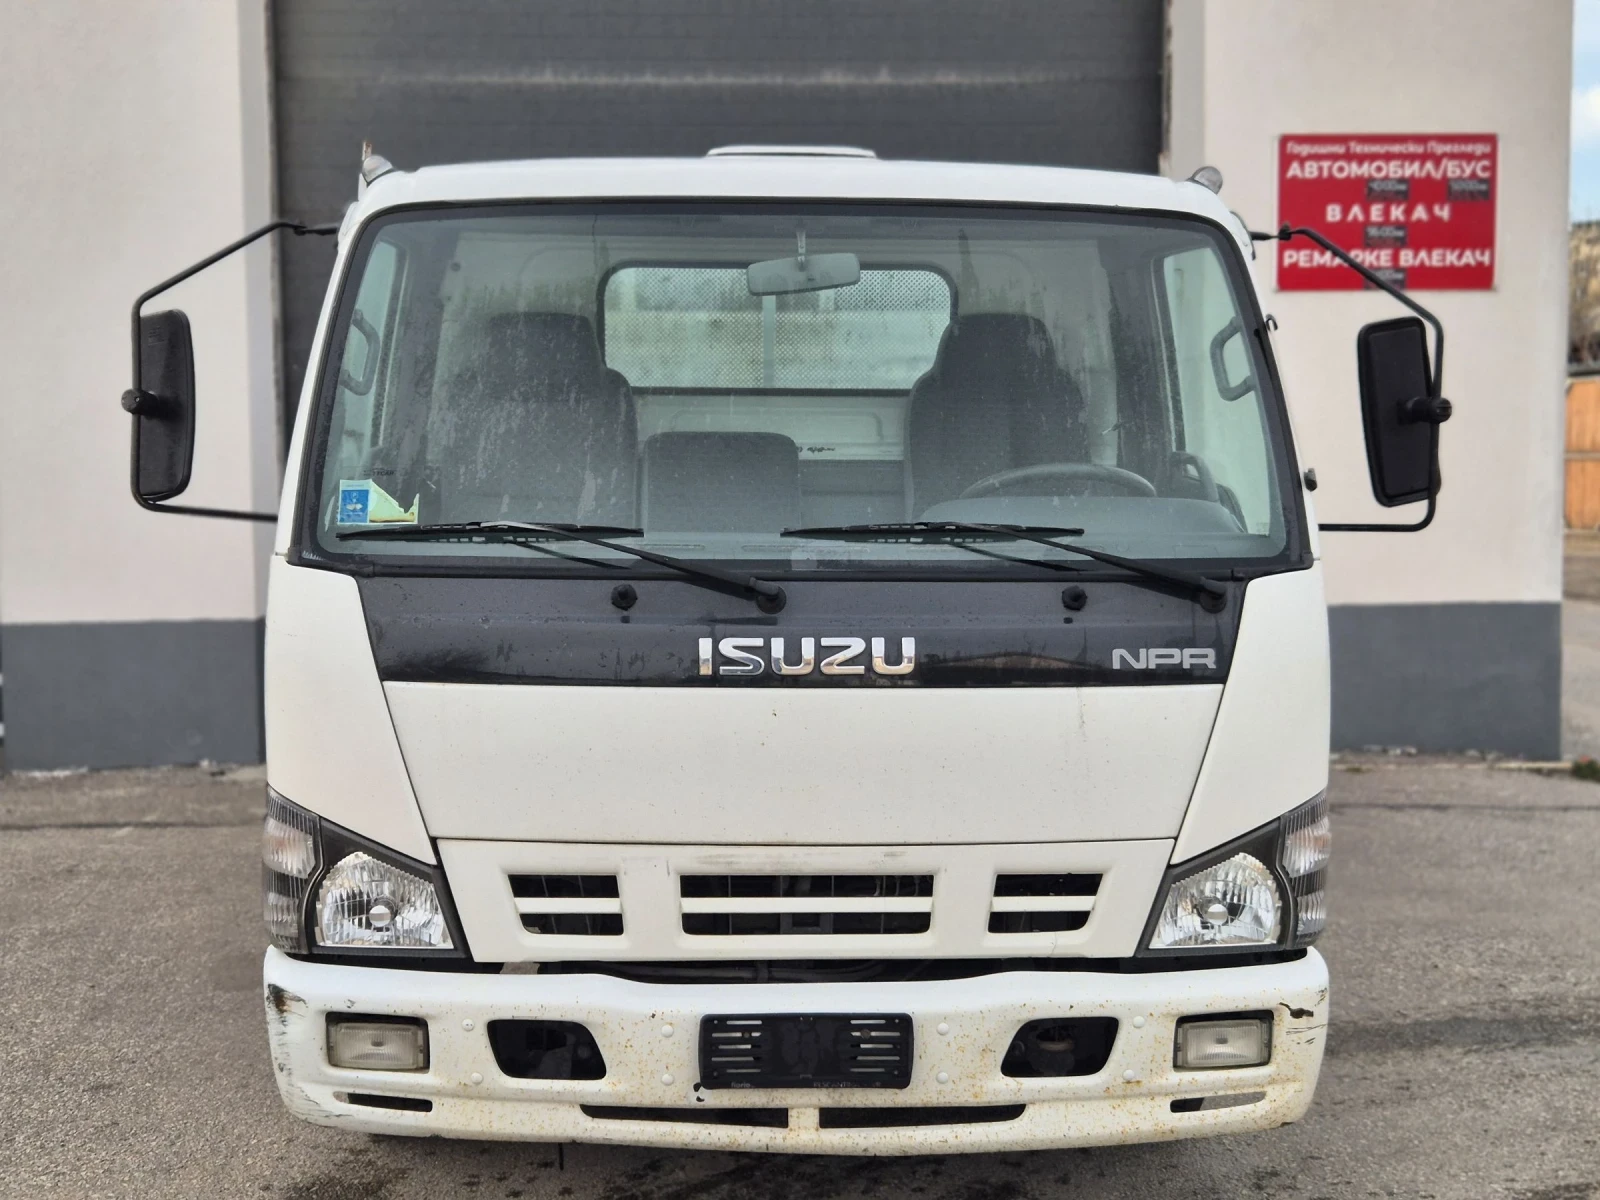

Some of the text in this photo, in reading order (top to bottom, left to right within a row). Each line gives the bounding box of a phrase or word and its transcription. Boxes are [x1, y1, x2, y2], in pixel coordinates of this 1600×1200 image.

[1286, 159, 1491, 178] АВТОМОБИЛ/БУС
[1326, 204, 1450, 222] ВЛЕКАЧ
[1399, 249, 1491, 267] ВЛЕКАЧ
[698, 637, 916, 676] ISUZU
[1111, 648, 1217, 670] NPR
